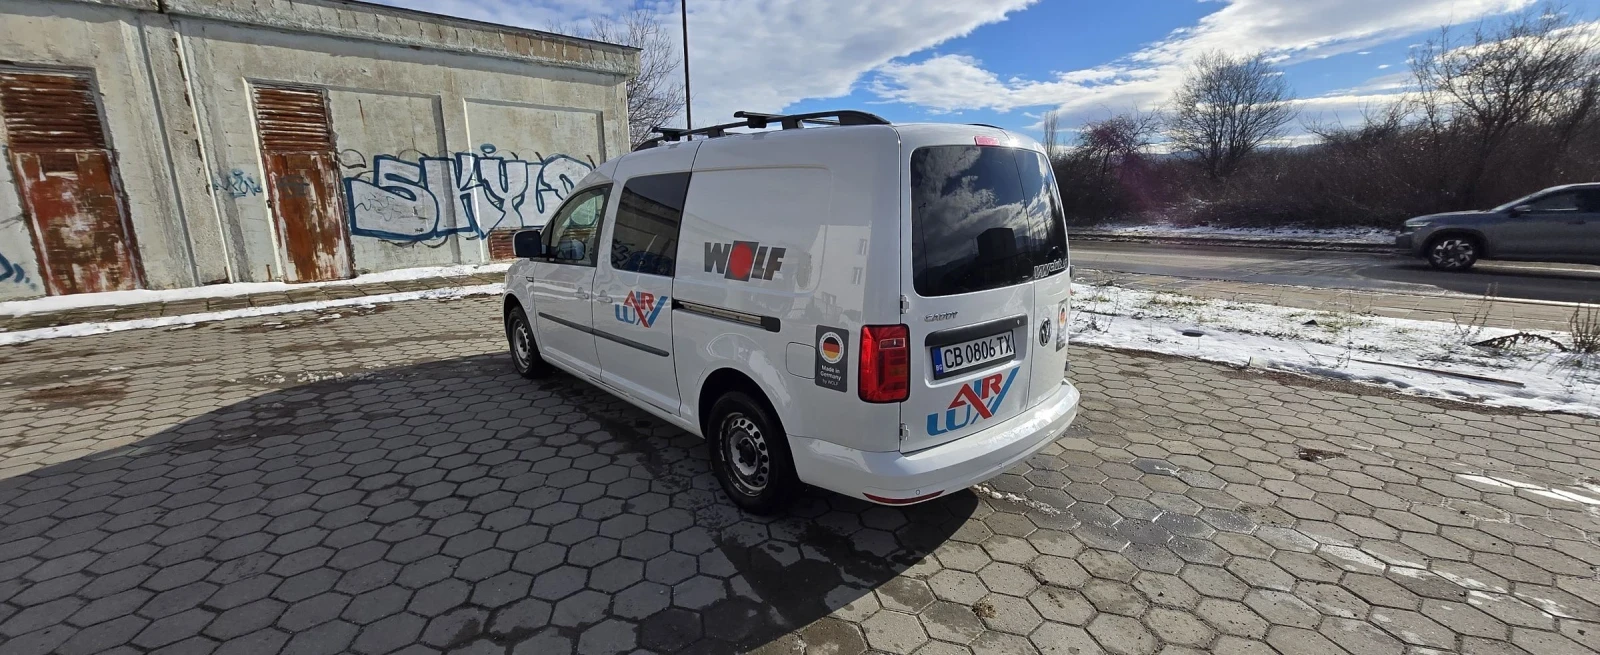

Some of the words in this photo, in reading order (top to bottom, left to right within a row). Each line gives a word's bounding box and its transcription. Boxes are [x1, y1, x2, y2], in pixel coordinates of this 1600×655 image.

[704, 240, 787, 282] WOLF
[923, 311, 959, 322] CADDY
[944, 348, 963, 369] CB
[966, 339, 996, 363] 0806
[997, 333, 1013, 355] TX
[821, 365, 834, 373] Made
[820, 371, 841, 381] Germany
